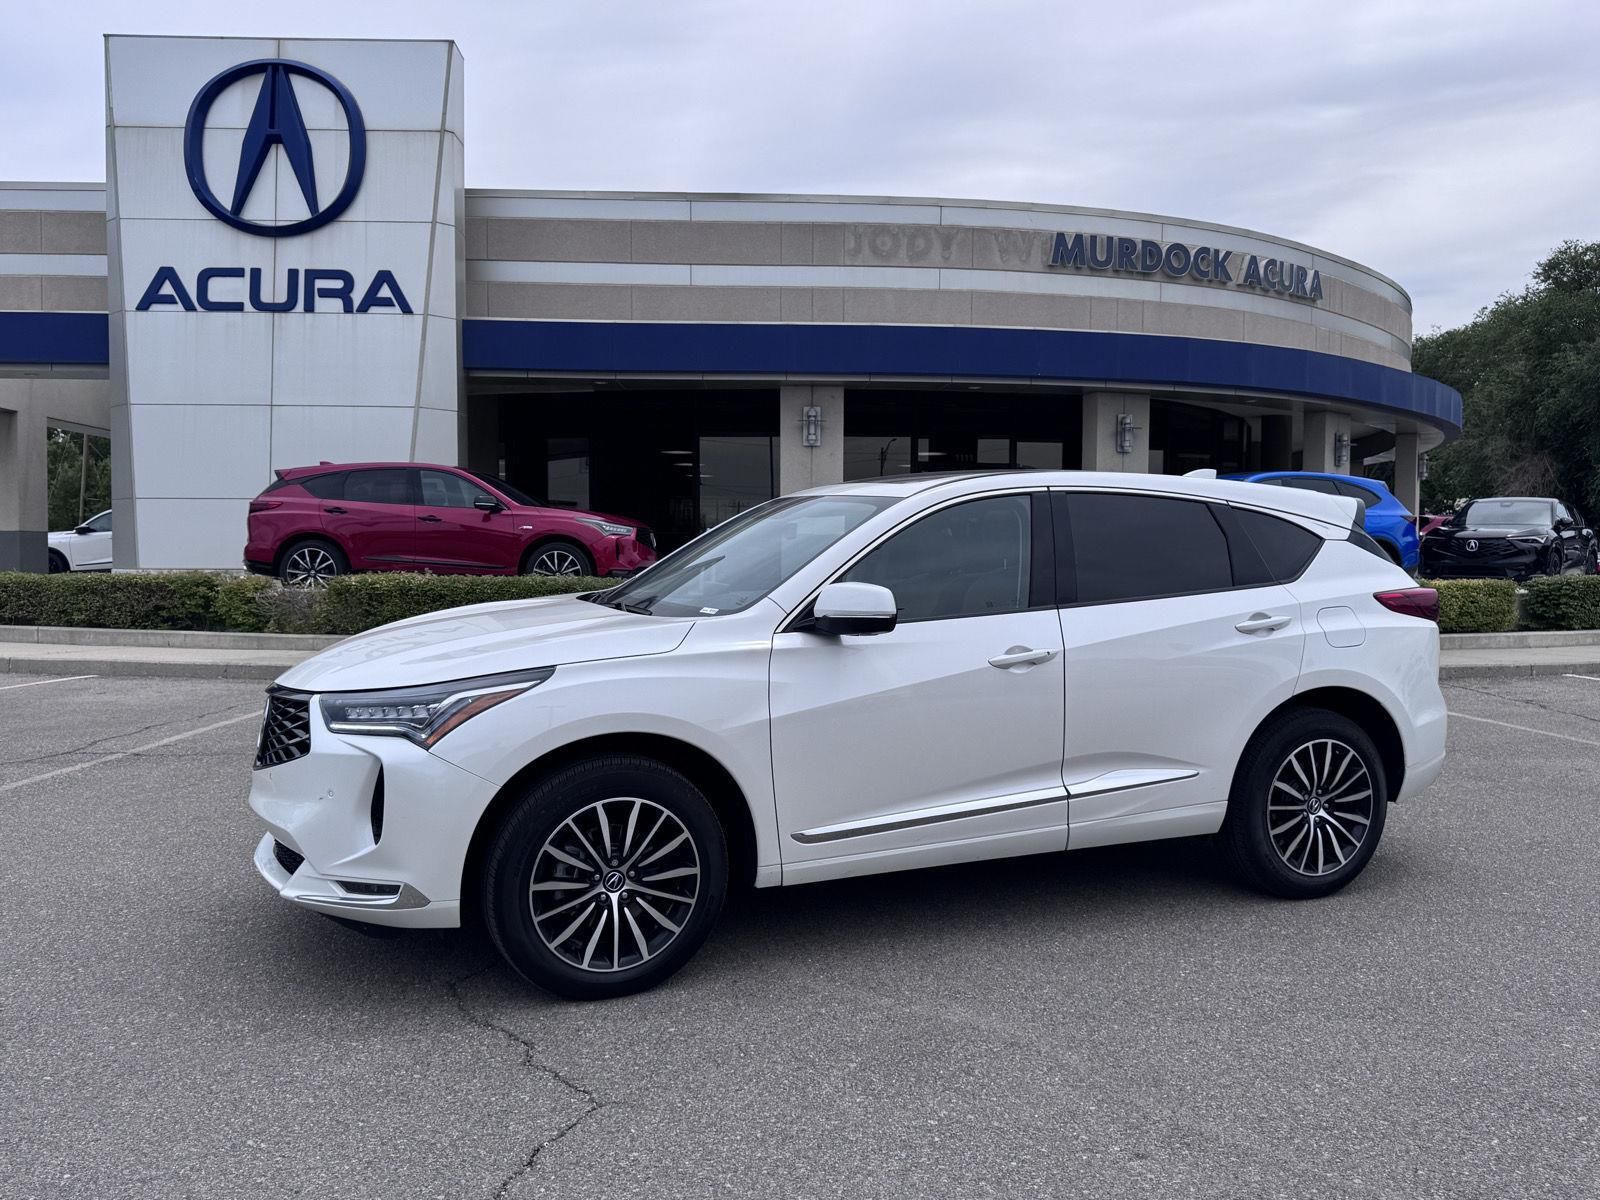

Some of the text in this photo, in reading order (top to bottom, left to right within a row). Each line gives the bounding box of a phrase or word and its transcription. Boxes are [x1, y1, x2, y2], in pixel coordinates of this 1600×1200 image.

[136, 266, 414, 314] ACURA
[1050, 231, 1233, 282] MURDOCK
[1241, 254, 1323, 301] ACURA
